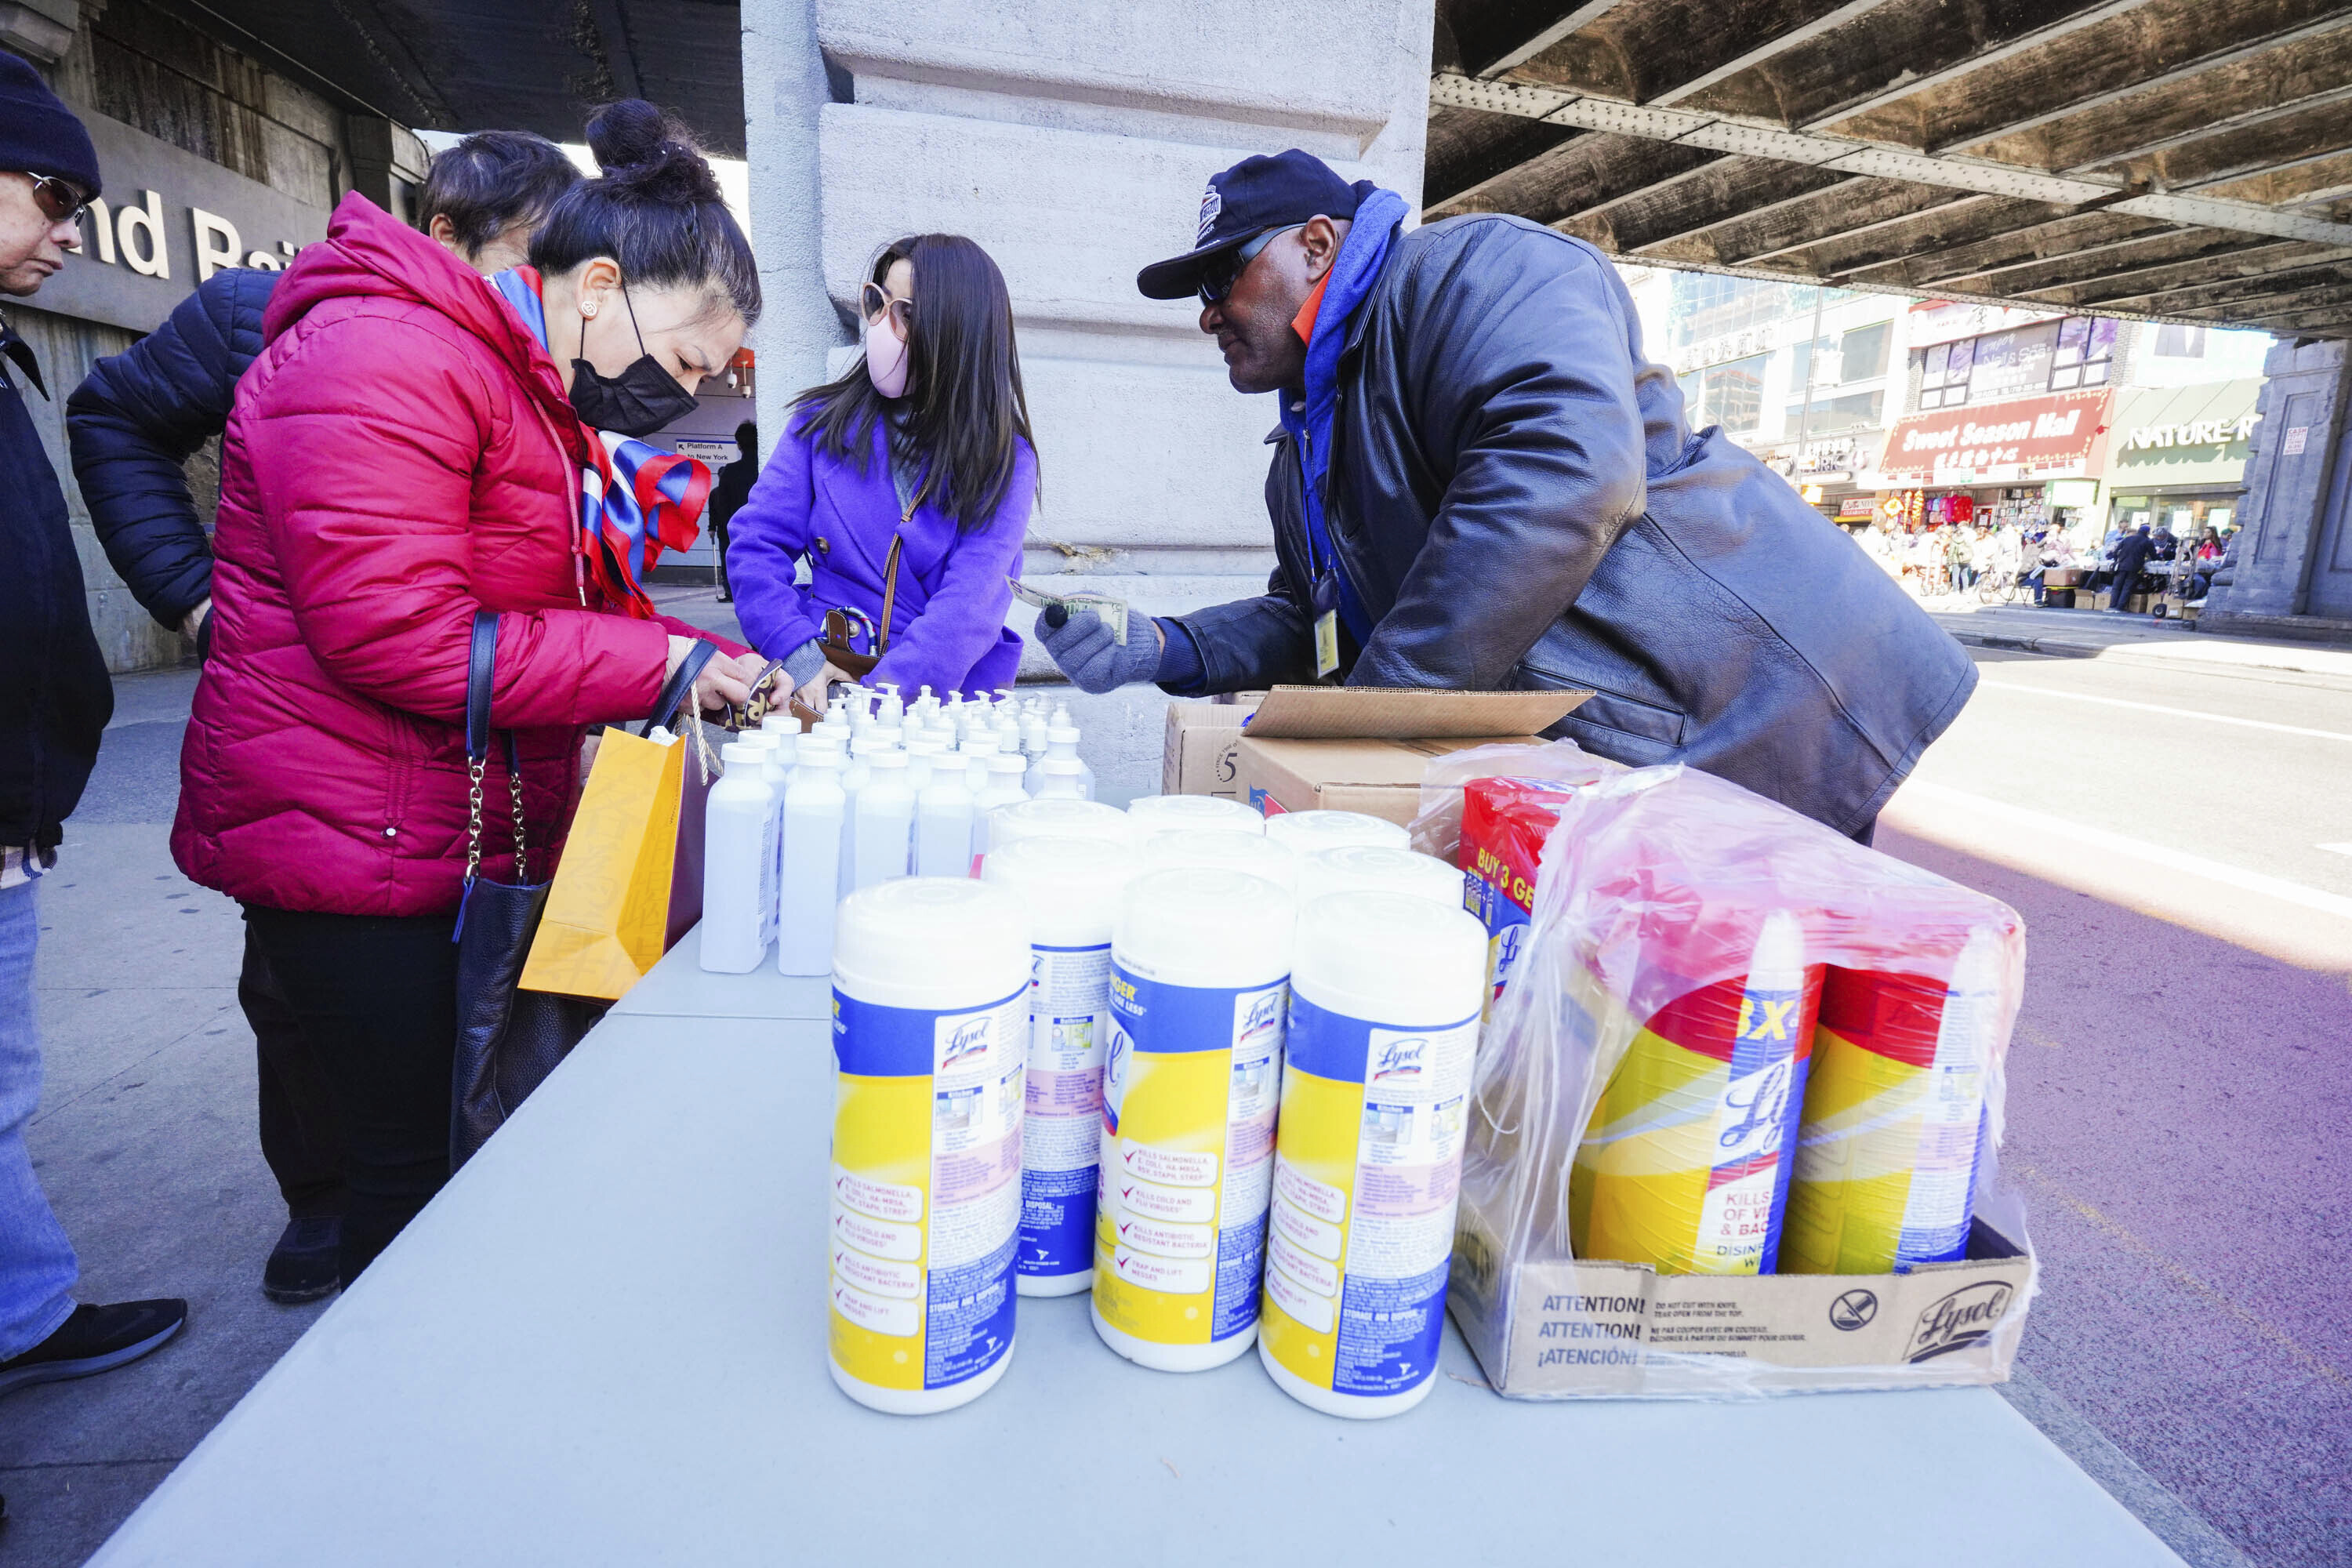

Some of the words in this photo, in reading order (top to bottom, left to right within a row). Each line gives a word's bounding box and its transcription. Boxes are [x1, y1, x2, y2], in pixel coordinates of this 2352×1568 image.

[1903, 425, 1958, 452] Sweet
[1960, 420, 2031, 448] Season
[2032, 409, 2081, 439] Mall
[2128, 418, 2232, 450] NATURE
[2237, 415, 2263, 441] R
[1222, 752, 1238, 782] 5
[1478, 847, 1501, 879] BUY
[1501, 865, 1509, 888] 3
[946, 1018, 991, 1056] Lysol
[1377, 1042, 1427, 1069] Lysol
[1726, 1191, 1770, 1206] KILLS
[1723, 1207, 1748, 1221] OF
[1753, 1205, 1771, 1219] VI
[880, 1232, 896, 1241] AND
[1720, 1223, 1731, 1236] &
[961, 1295, 975, 1307] AND
[1541, 1294, 1646, 1314] ATTENTION!
[1374, 1312, 1389, 1322] AND
[1918, 1287, 2006, 1346] Lysol
[1538, 1321, 1642, 1340] ATTENTION!
[1537, 1345, 1639, 1367] ¡ATENCIÓN!
